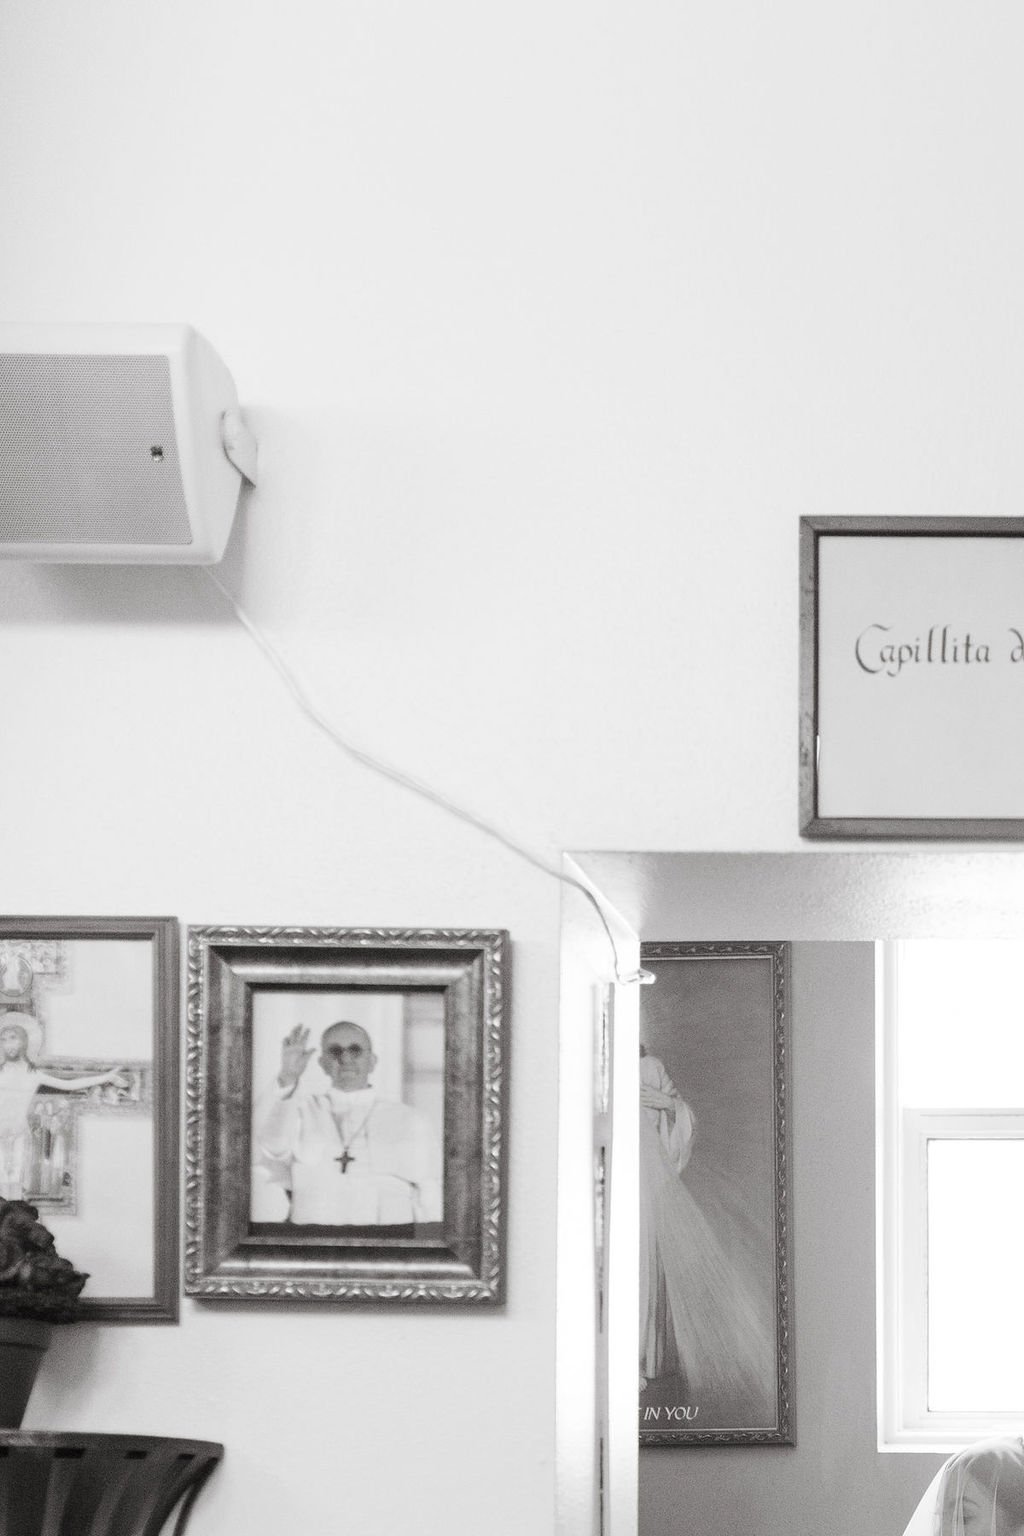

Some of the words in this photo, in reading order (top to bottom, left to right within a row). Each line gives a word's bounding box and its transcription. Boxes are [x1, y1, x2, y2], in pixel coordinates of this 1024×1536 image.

[855, 623, 991, 677] Capillita
[644, 1406, 661, 1420] IN
[664, 1406, 699, 1420] YOU
